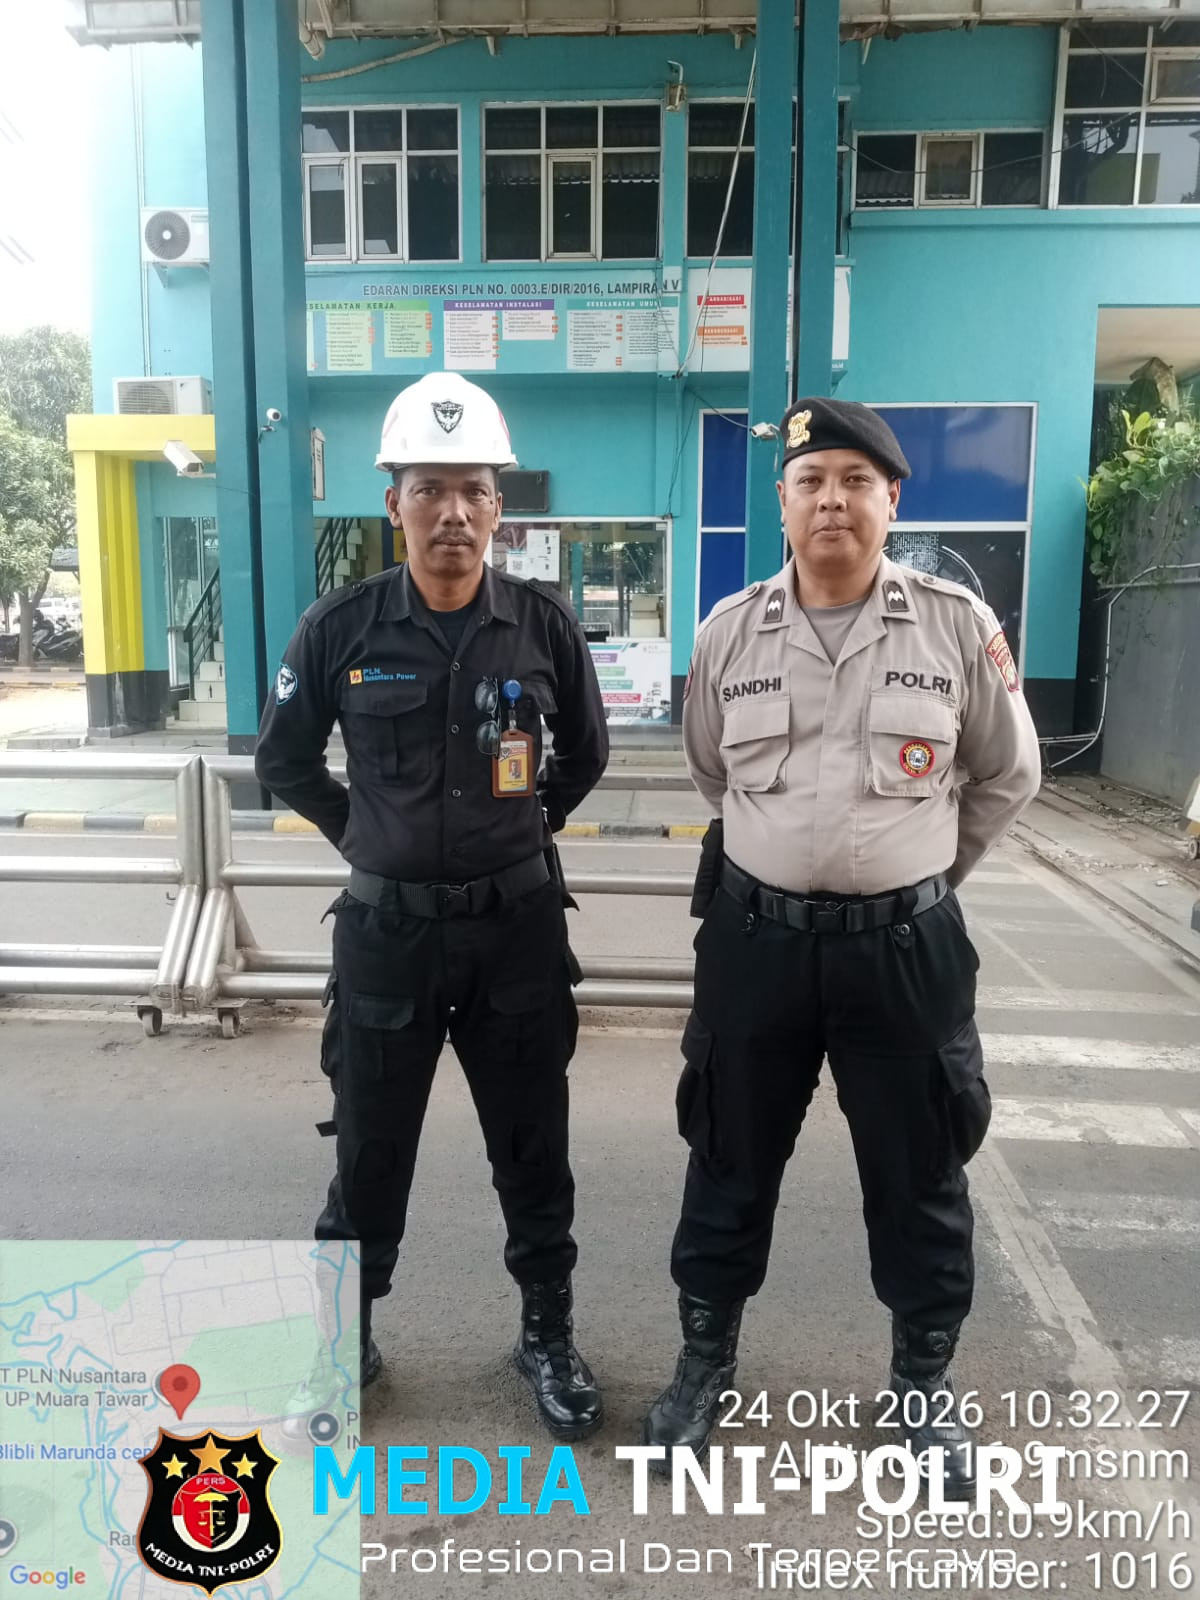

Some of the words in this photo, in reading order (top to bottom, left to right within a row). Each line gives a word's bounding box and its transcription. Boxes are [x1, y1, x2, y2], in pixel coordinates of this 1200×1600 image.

[363, 284, 409, 296] EDARAN
[412, 283, 458, 296] DIREKSI
[462, 283, 484, 295] PLN
[487, 283, 507, 295] NO.
[607, 279, 667, 294] LAMPIRAN
[671, 279, 680, 290] V
[307, 302, 361, 310] SELAMATAN
[366, 302, 395, 310] KERJA
[363, 667, 381, 675] PLN
[722, 676, 782, 702] SANDHI
[884, 670, 953, 696] POLRI
